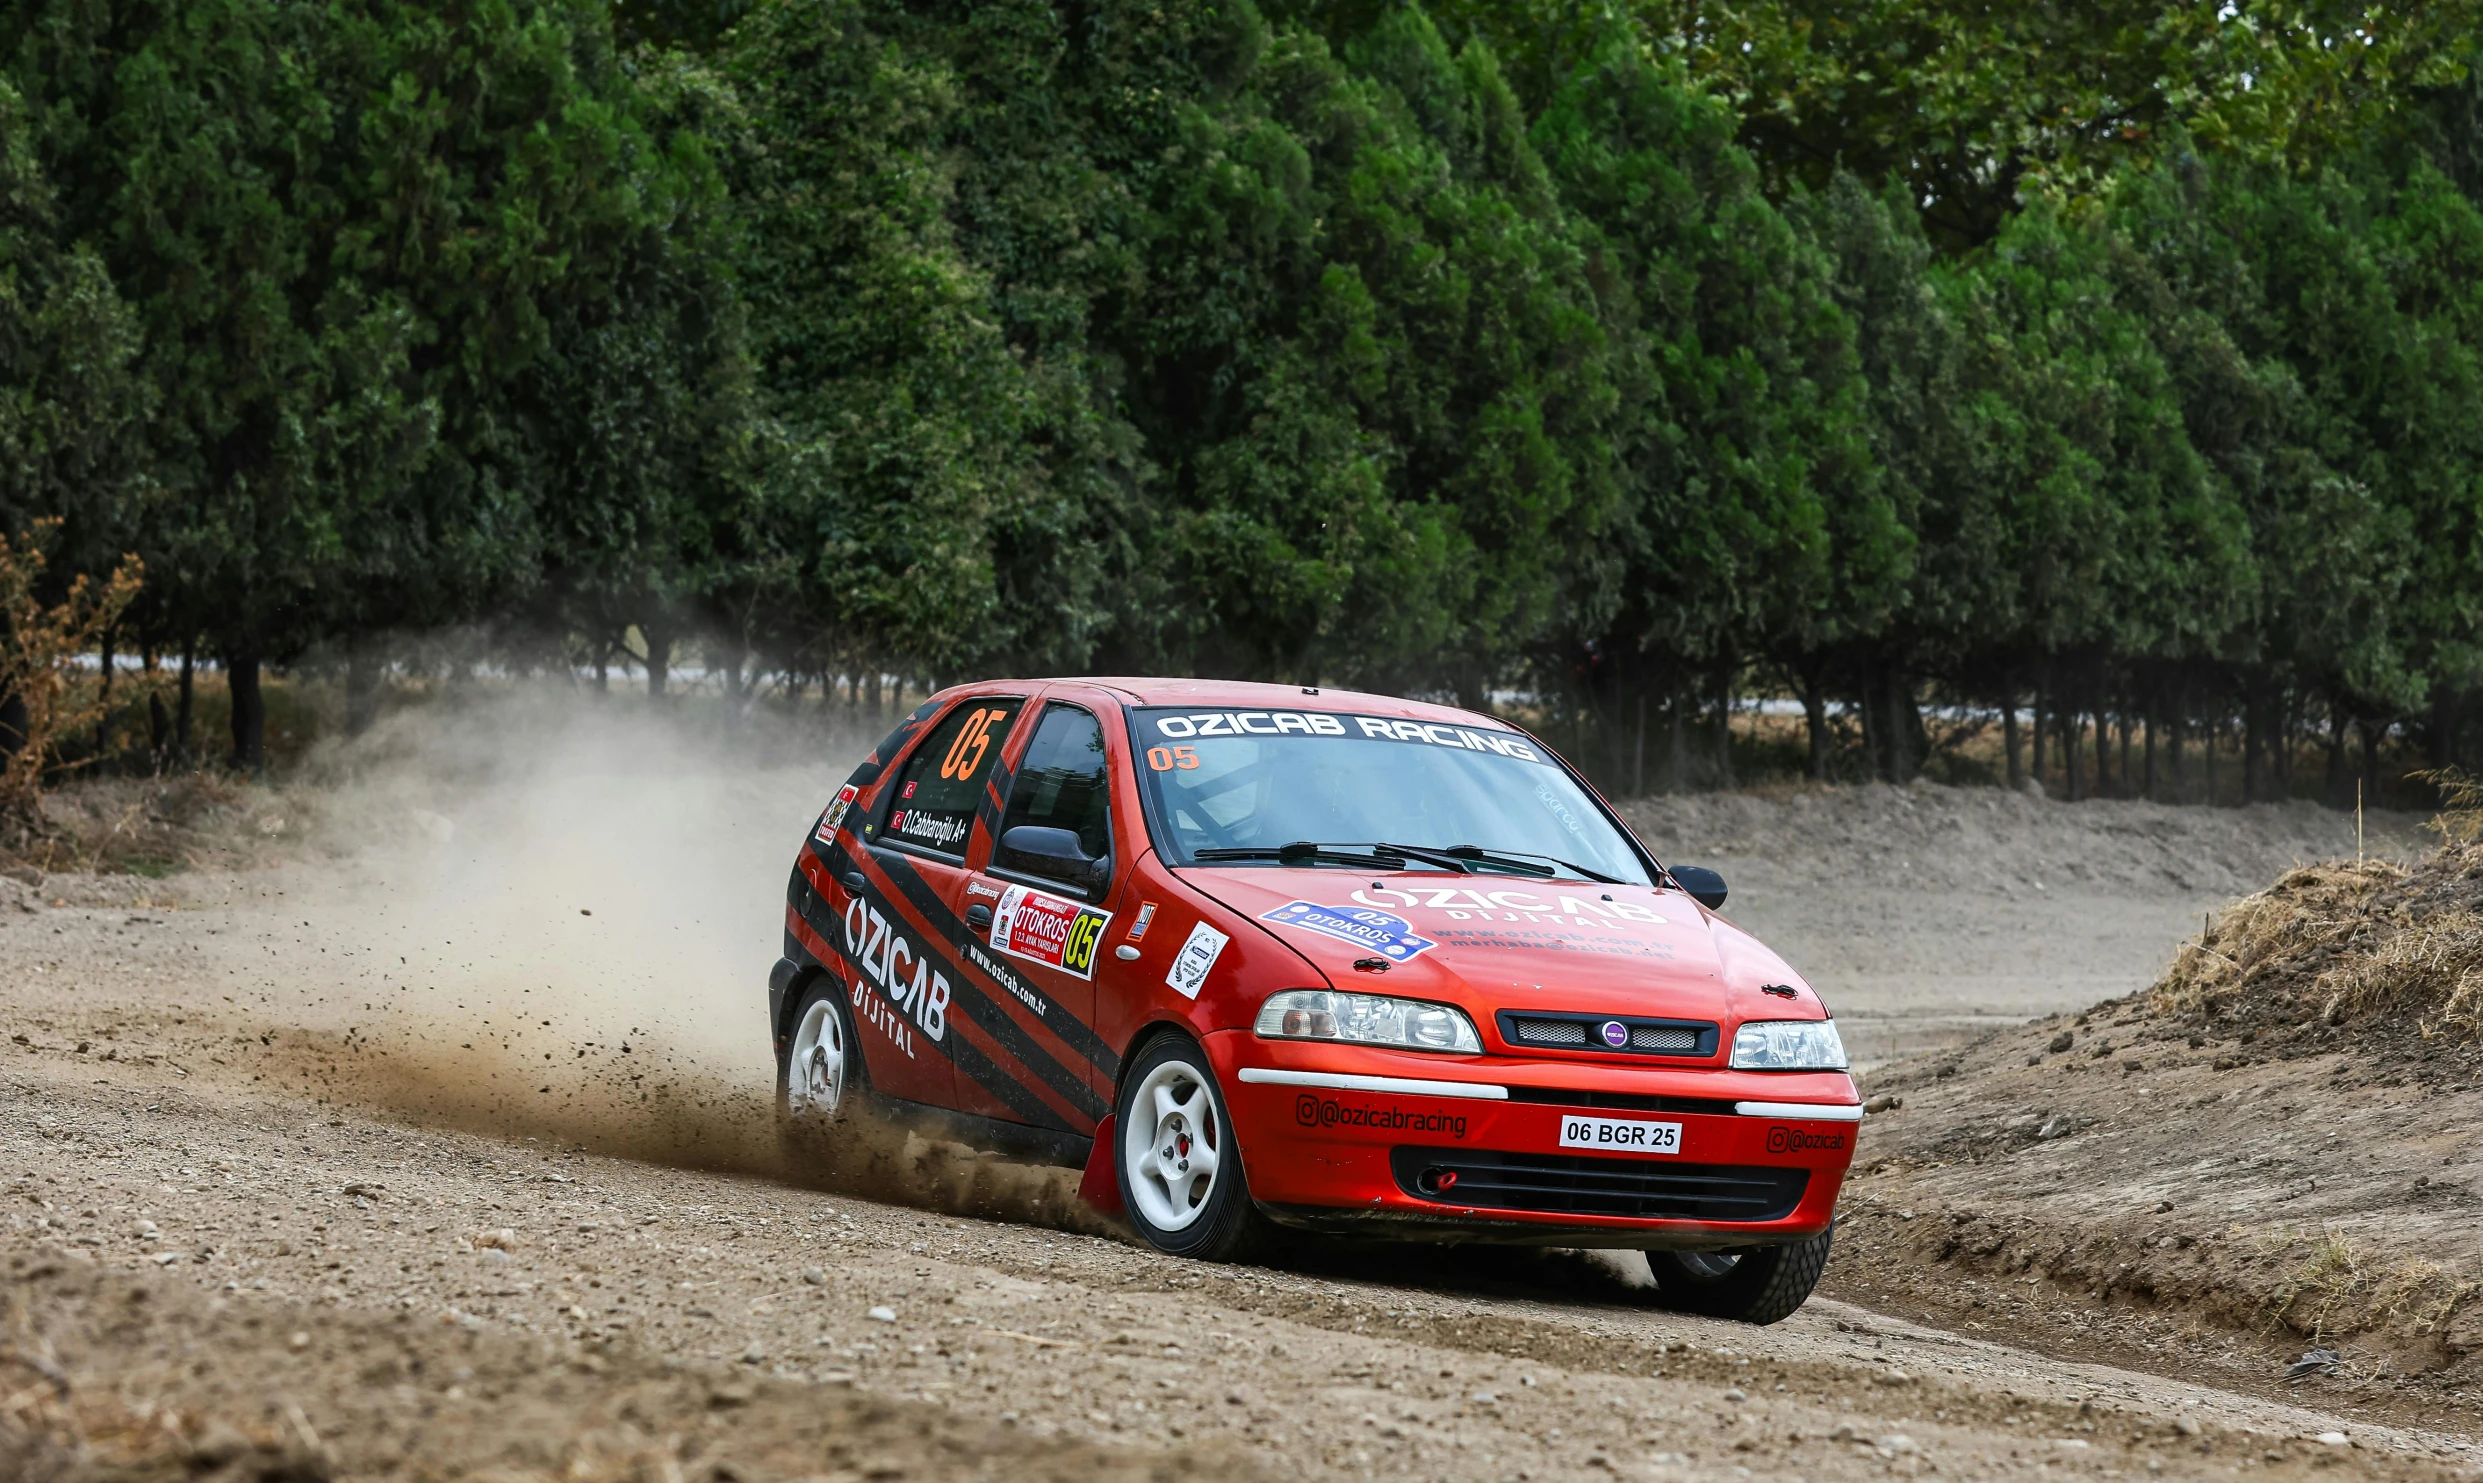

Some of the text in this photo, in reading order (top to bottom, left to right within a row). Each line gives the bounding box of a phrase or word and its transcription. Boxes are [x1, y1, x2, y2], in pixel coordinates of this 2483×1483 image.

[940, 707, 1007, 781] 05
[1156, 712, 1540, 763] OZICAB RACING
[1147, 746, 1200, 772] 05
[951, 819, 967, 843] A+
[1014, 906, 1070, 942] OTOKROS
[1350, 888, 1668, 925] OZICAB
[1352, 911, 1395, 926] 05
[1065, 914, 1103, 969] 05
[1304, 913, 1396, 944] OTOKROS
[1431, 930, 1676, 950] www.ozicab.com.tr
[845, 897, 950, 1042] OZICAB
[970, 944, 1047, 1017] www.ozicab.com.tr
[1320, 1100, 1467, 1139] @ozicabracing
[1567, 1122, 1675, 1147] 06 BGR 25
[1788, 1129, 1845, 1152] @ozicab
